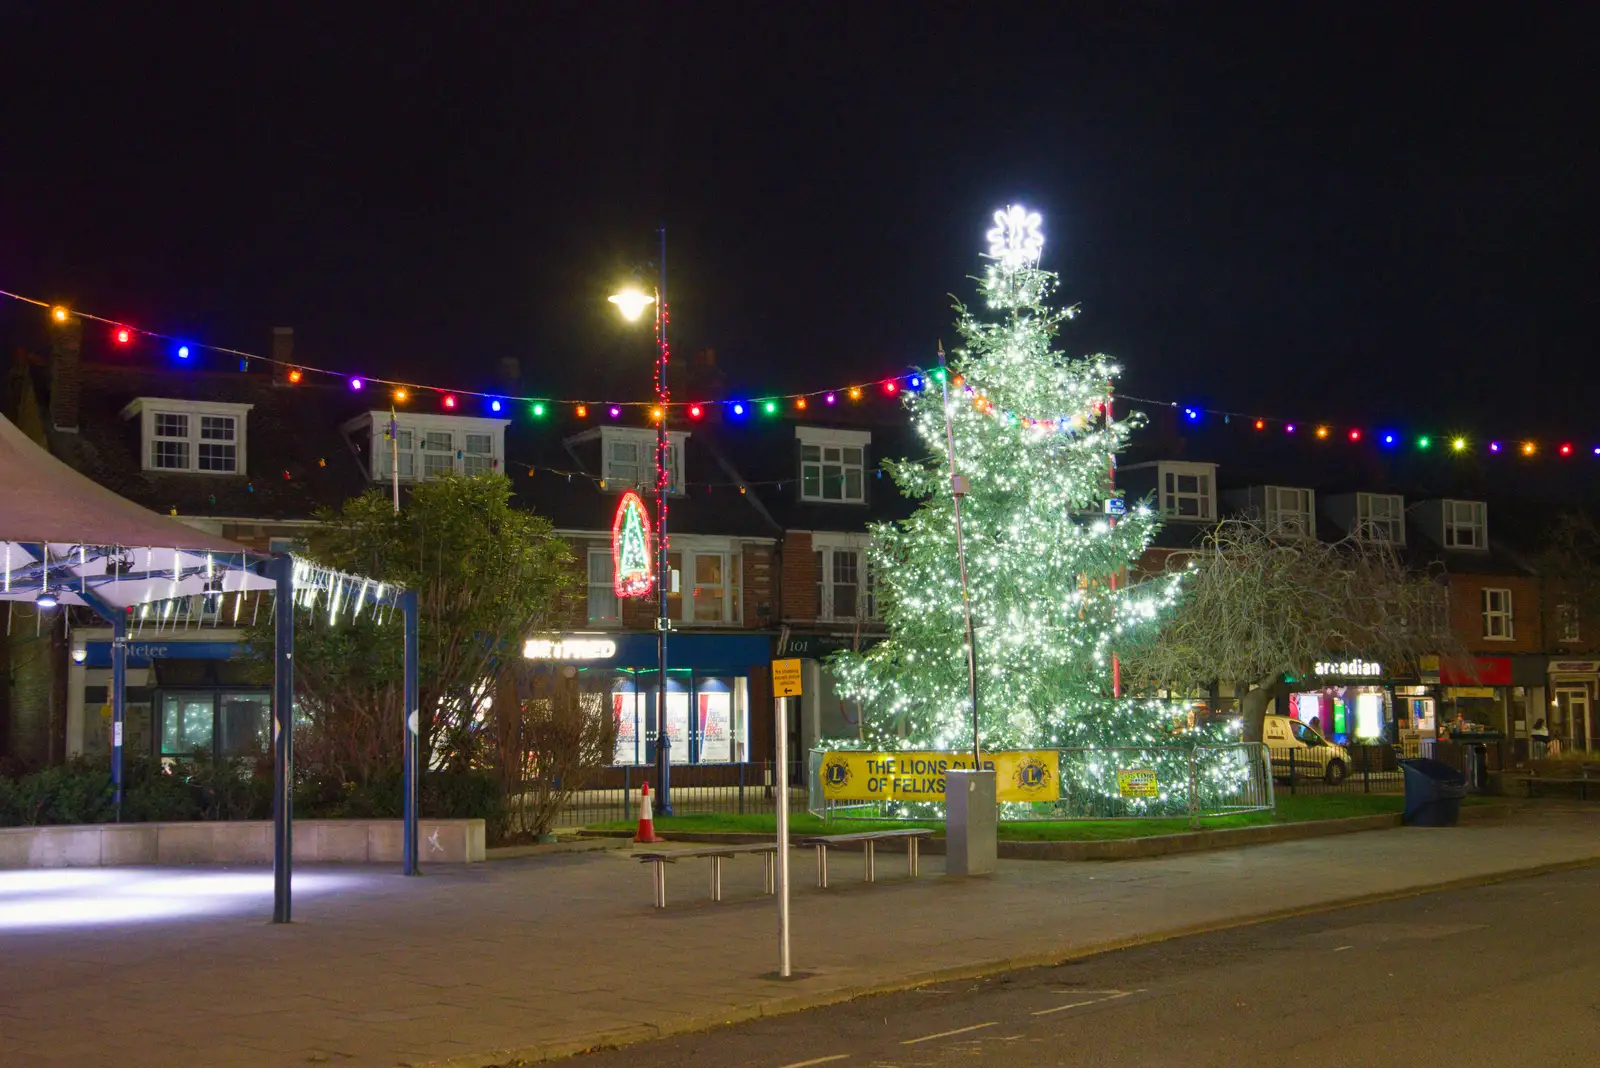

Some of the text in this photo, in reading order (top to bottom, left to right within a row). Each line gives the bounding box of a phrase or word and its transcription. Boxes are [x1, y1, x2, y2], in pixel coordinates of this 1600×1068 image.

[1315, 658, 1380, 676] arcadian
[866, 760, 896, 775] THE
[901, 760, 948, 775] LIONS
[867, 778, 946, 793] OF FELIXS
